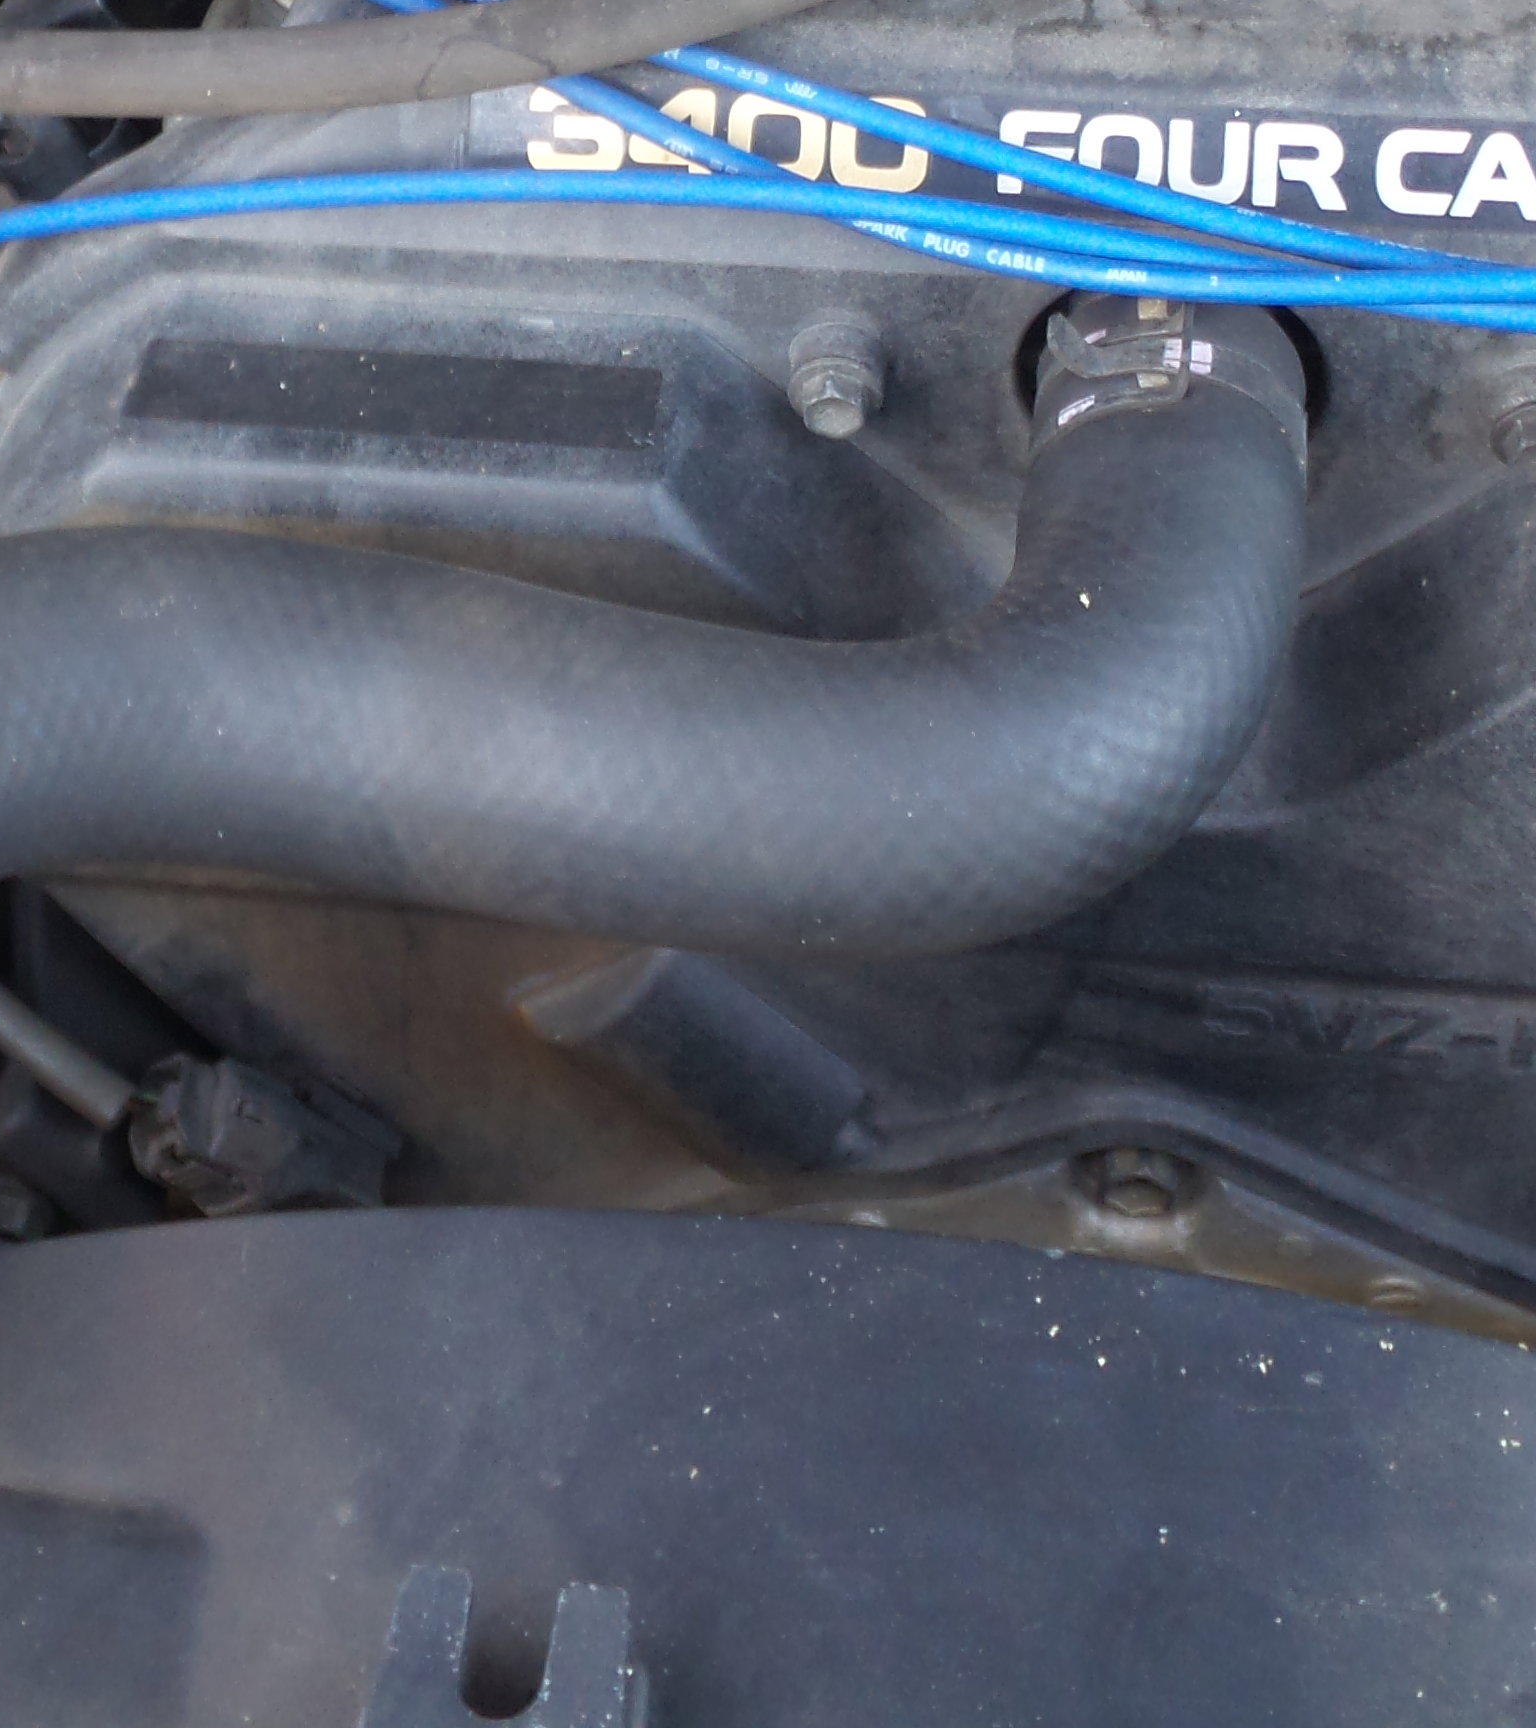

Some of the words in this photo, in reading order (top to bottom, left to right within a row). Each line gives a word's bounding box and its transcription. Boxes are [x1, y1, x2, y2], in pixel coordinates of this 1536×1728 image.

[526, 84, 930, 194] 3400
[996, 111, 1348, 213] FOUR
[922, 231, 971, 259] PLUG
[985, 248, 1047, 274] CABLE
[1104, 267, 1148, 284] JAPAN
